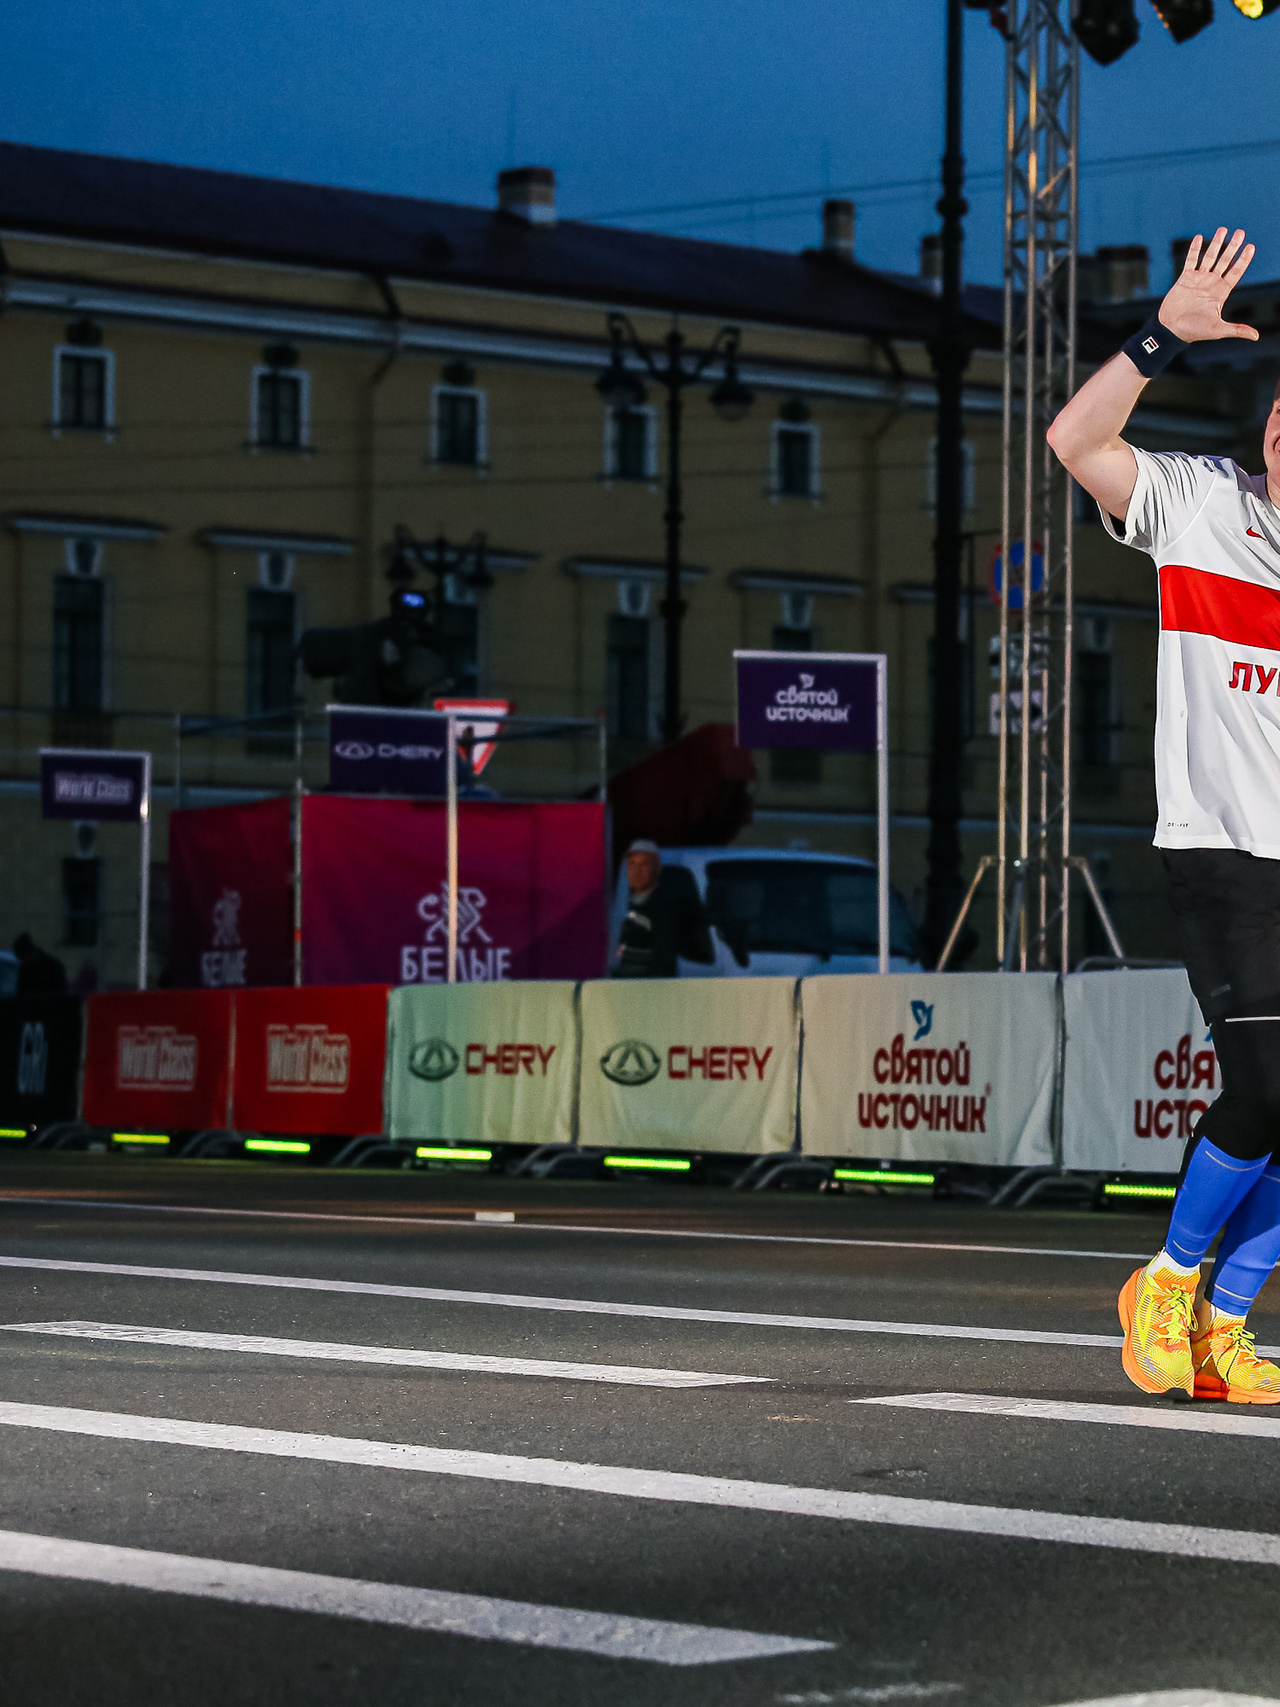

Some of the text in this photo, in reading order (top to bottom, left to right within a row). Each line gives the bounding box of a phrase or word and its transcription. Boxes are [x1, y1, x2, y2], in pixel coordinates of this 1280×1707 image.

[378, 743, 443, 760] CHERY
[465, 1043, 556, 1075] CHERY
[668, 1046, 773, 1080] CHERY
[1154, 1033, 1224, 1090] свя
